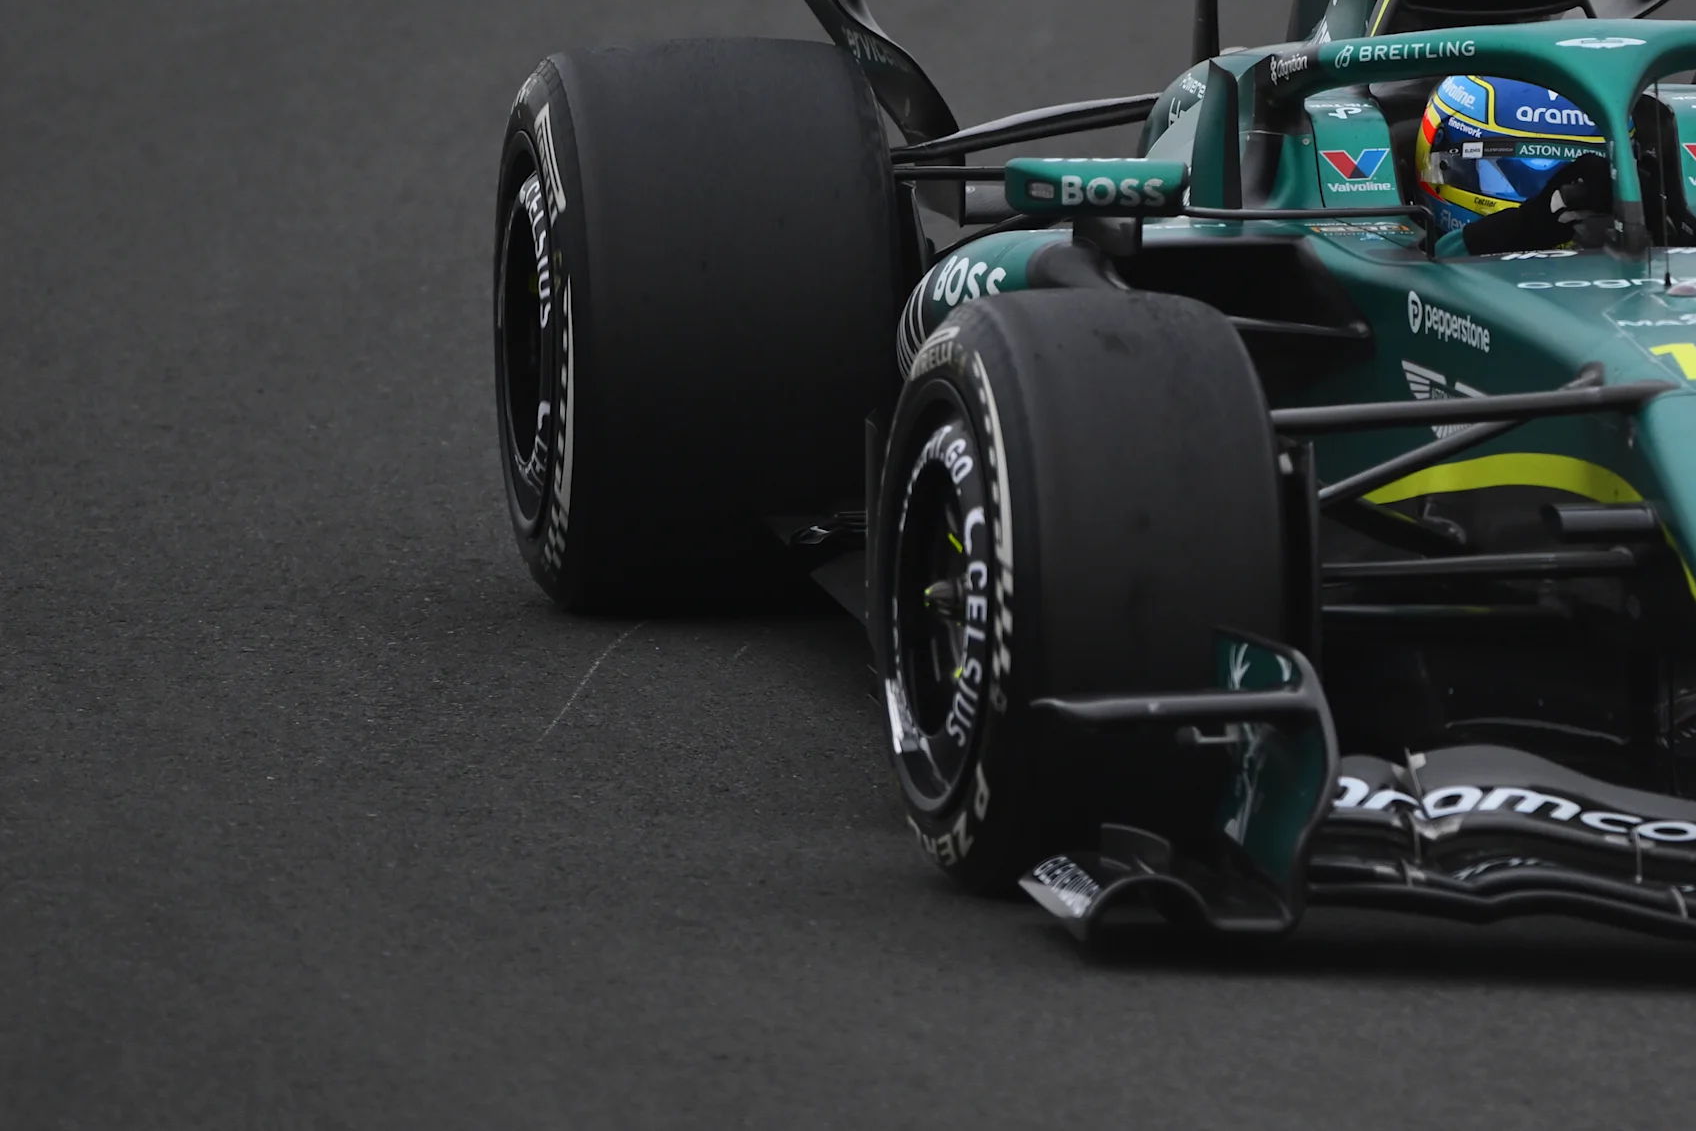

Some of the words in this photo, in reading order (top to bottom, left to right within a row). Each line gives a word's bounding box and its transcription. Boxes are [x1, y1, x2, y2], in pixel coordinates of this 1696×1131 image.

[1359, 40, 1476, 62] BREITLING
[1179, 72, 1206, 99] Powere
[1519, 145, 1561, 156] ASTON
[1061, 175, 1166, 207] BOSS
[1327, 181, 1391, 193] Valvoline
[525, 179, 552, 330] CELSIUS
[1425, 304, 1491, 353] pepperstone
[946, 559, 989, 748] CELSIUS
